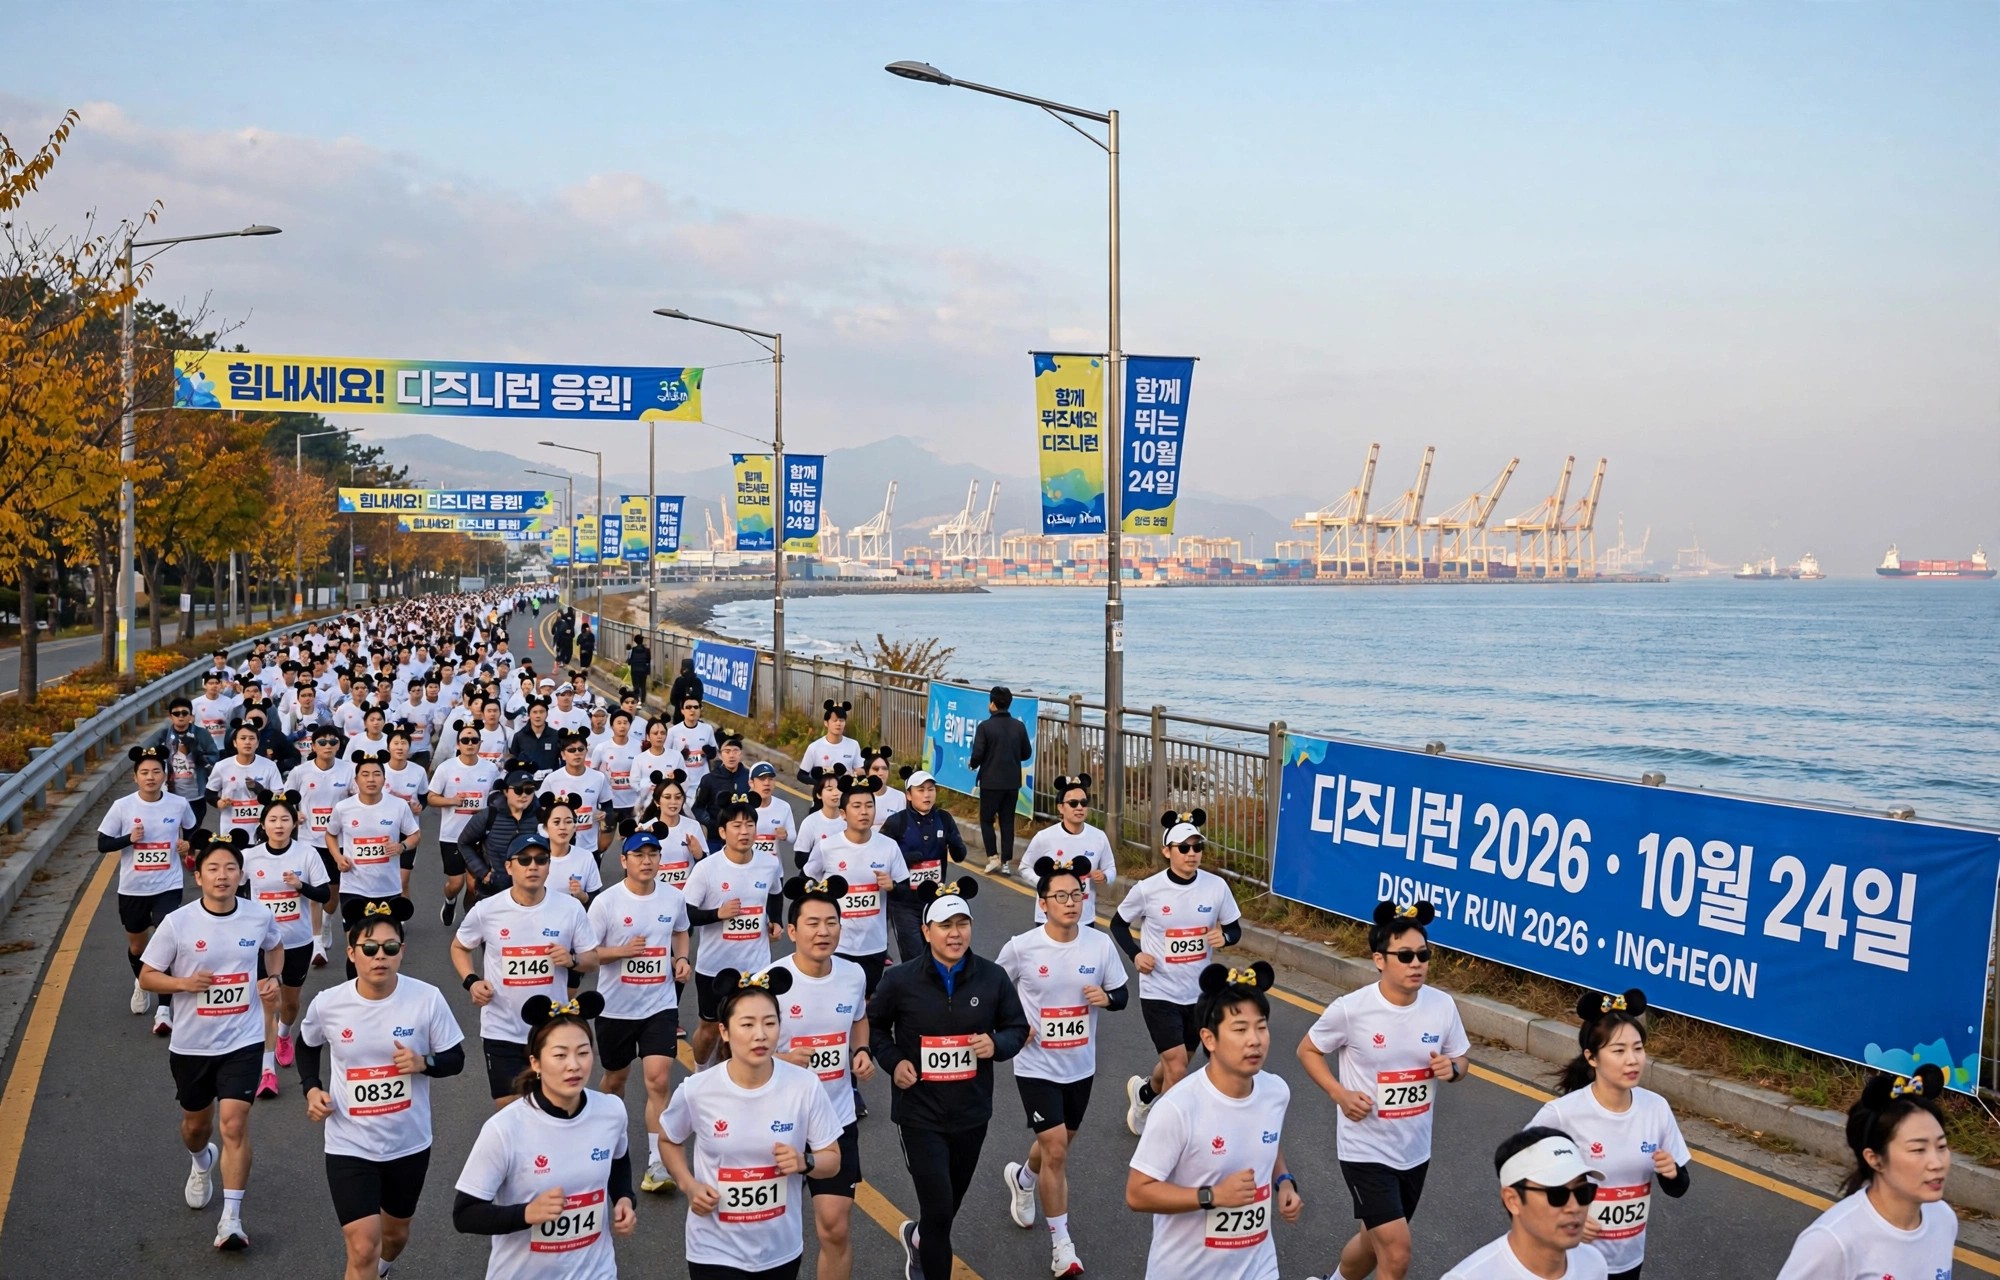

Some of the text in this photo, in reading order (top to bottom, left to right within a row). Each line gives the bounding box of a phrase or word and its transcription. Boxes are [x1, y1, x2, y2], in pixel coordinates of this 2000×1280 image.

[228, 362, 632, 412] 힘내세요! 디즈니런 응원!
[1135, 377, 1181, 404] 함께
[1055, 388, 1084, 407] 함께
[1134, 409, 1179, 436] 뛰는
[1042, 434, 1098, 452] 디즈니런
[1131, 440, 1177, 466] 10월
[790, 464, 816, 480] 함께
[789, 482, 816, 497] 뛰는
[1128, 470, 1174, 495] 24일
[360, 493, 422, 509] 힘내세요!
[427, 494, 486, 510] 디즈니런
[490, 495, 523, 510] 응원!
[788, 500, 815, 514] 10월
[786, 516, 815, 530] 24일
[137, 851, 168, 863] 3552
[1310, 773, 1463, 870] 디즈니런
[1470, 802, 1592, 894] 2026
[1638, 832, 1754, 935] 10월
[1763, 855, 1917, 972] 24일
[1171, 939, 1204, 953] 0953
[1464, 893, 1517, 937] RUN
[1522, 907, 1588, 956] 2026
[1614, 930, 1758, 999] INCHEON
[508, 959, 549, 975] 2146
[627, 960, 661, 973] 0861
[204, 987, 244, 1004] 1207
[928, 1050, 971, 1068] 0914
[354, 1080, 405, 1102] 0832
[1385, 1084, 1427, 1105] 2783
[727, 1183, 778, 1207] 3561
[1215, 1206, 1265, 1232] 2739
[1598, 1202, 1645, 1224] 4052
[541, 1210, 595, 1237] 0914
